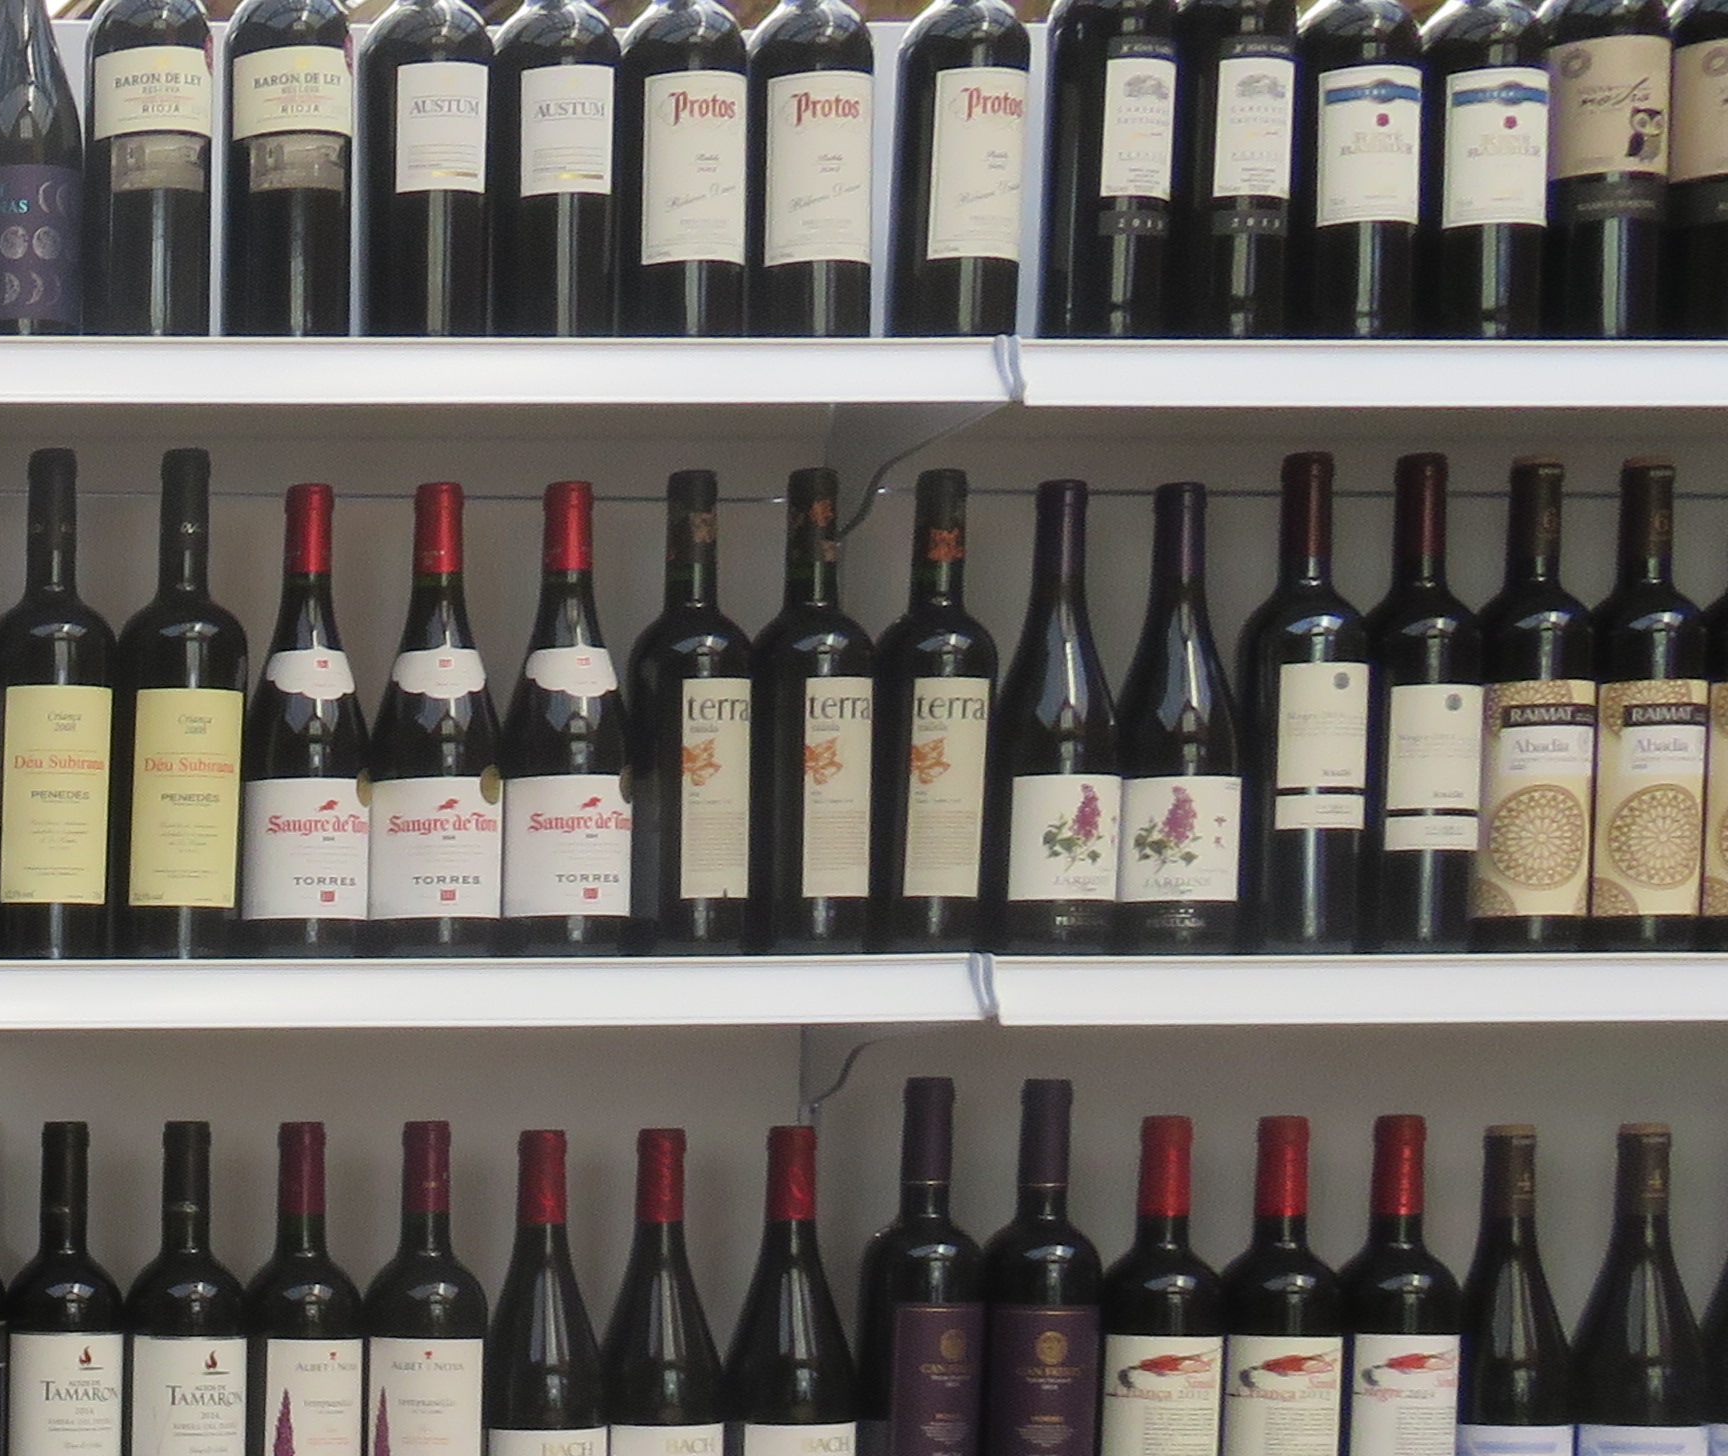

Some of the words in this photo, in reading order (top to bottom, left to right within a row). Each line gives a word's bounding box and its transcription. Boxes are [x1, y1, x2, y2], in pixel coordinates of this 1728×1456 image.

[114, 73, 158, 90] BARON
[162, 74, 176, 87] DE
[179, 73, 203, 87] LEY
[410, 97, 480, 117] AUSTUM
[533, 102, 606, 120] AUSTUM
[670, 91, 737, 125] Protos
[792, 91, 861, 126] Protos
[960, 86, 1024, 123] Protos
[686, 694, 752, 723] terra
[806, 692, 873, 722] terra
[913, 692, 990, 723] terra
[387, 812, 445, 840] Sangre
[448, 810, 471, 836] de
[292, 873, 357, 888] TORRES
[412, 872, 481, 887] TORRES
[391, 1360, 426, 1372] ALBET
